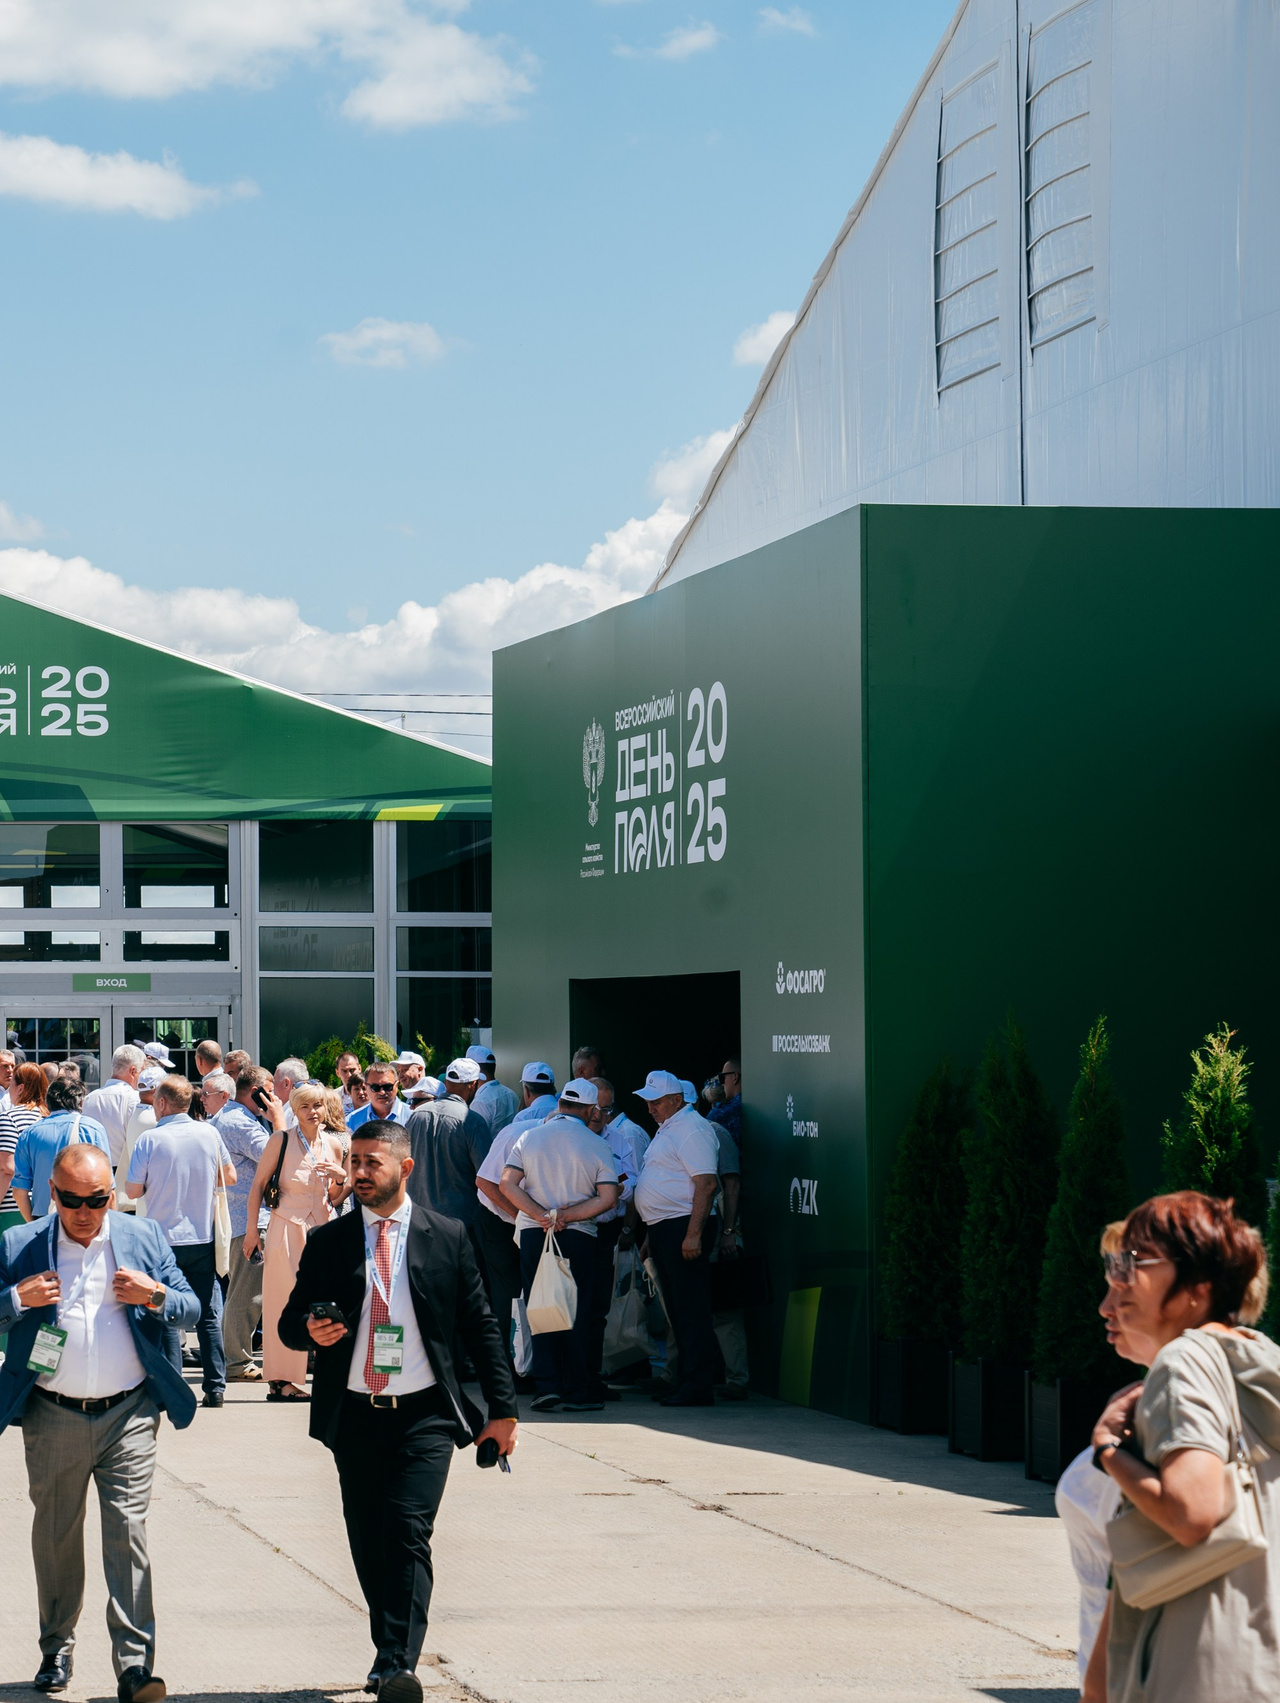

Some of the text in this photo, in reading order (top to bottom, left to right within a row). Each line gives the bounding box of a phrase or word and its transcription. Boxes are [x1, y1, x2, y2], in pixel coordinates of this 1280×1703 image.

[40, 665, 110, 698] 20
[40, 703, 110, 737] 25
[615, 689, 675, 732] ВСЕРОССИЙСКИЙ
[687, 681, 728, 769] 20
[615, 728, 675, 803] ДЕНЬ
[614, 800, 675, 875] ПОЛЯ
[687, 777, 728, 865] 25
[96, 978, 128, 988] ВХОД
[786, 968, 825, 994] ФОСАГРО
